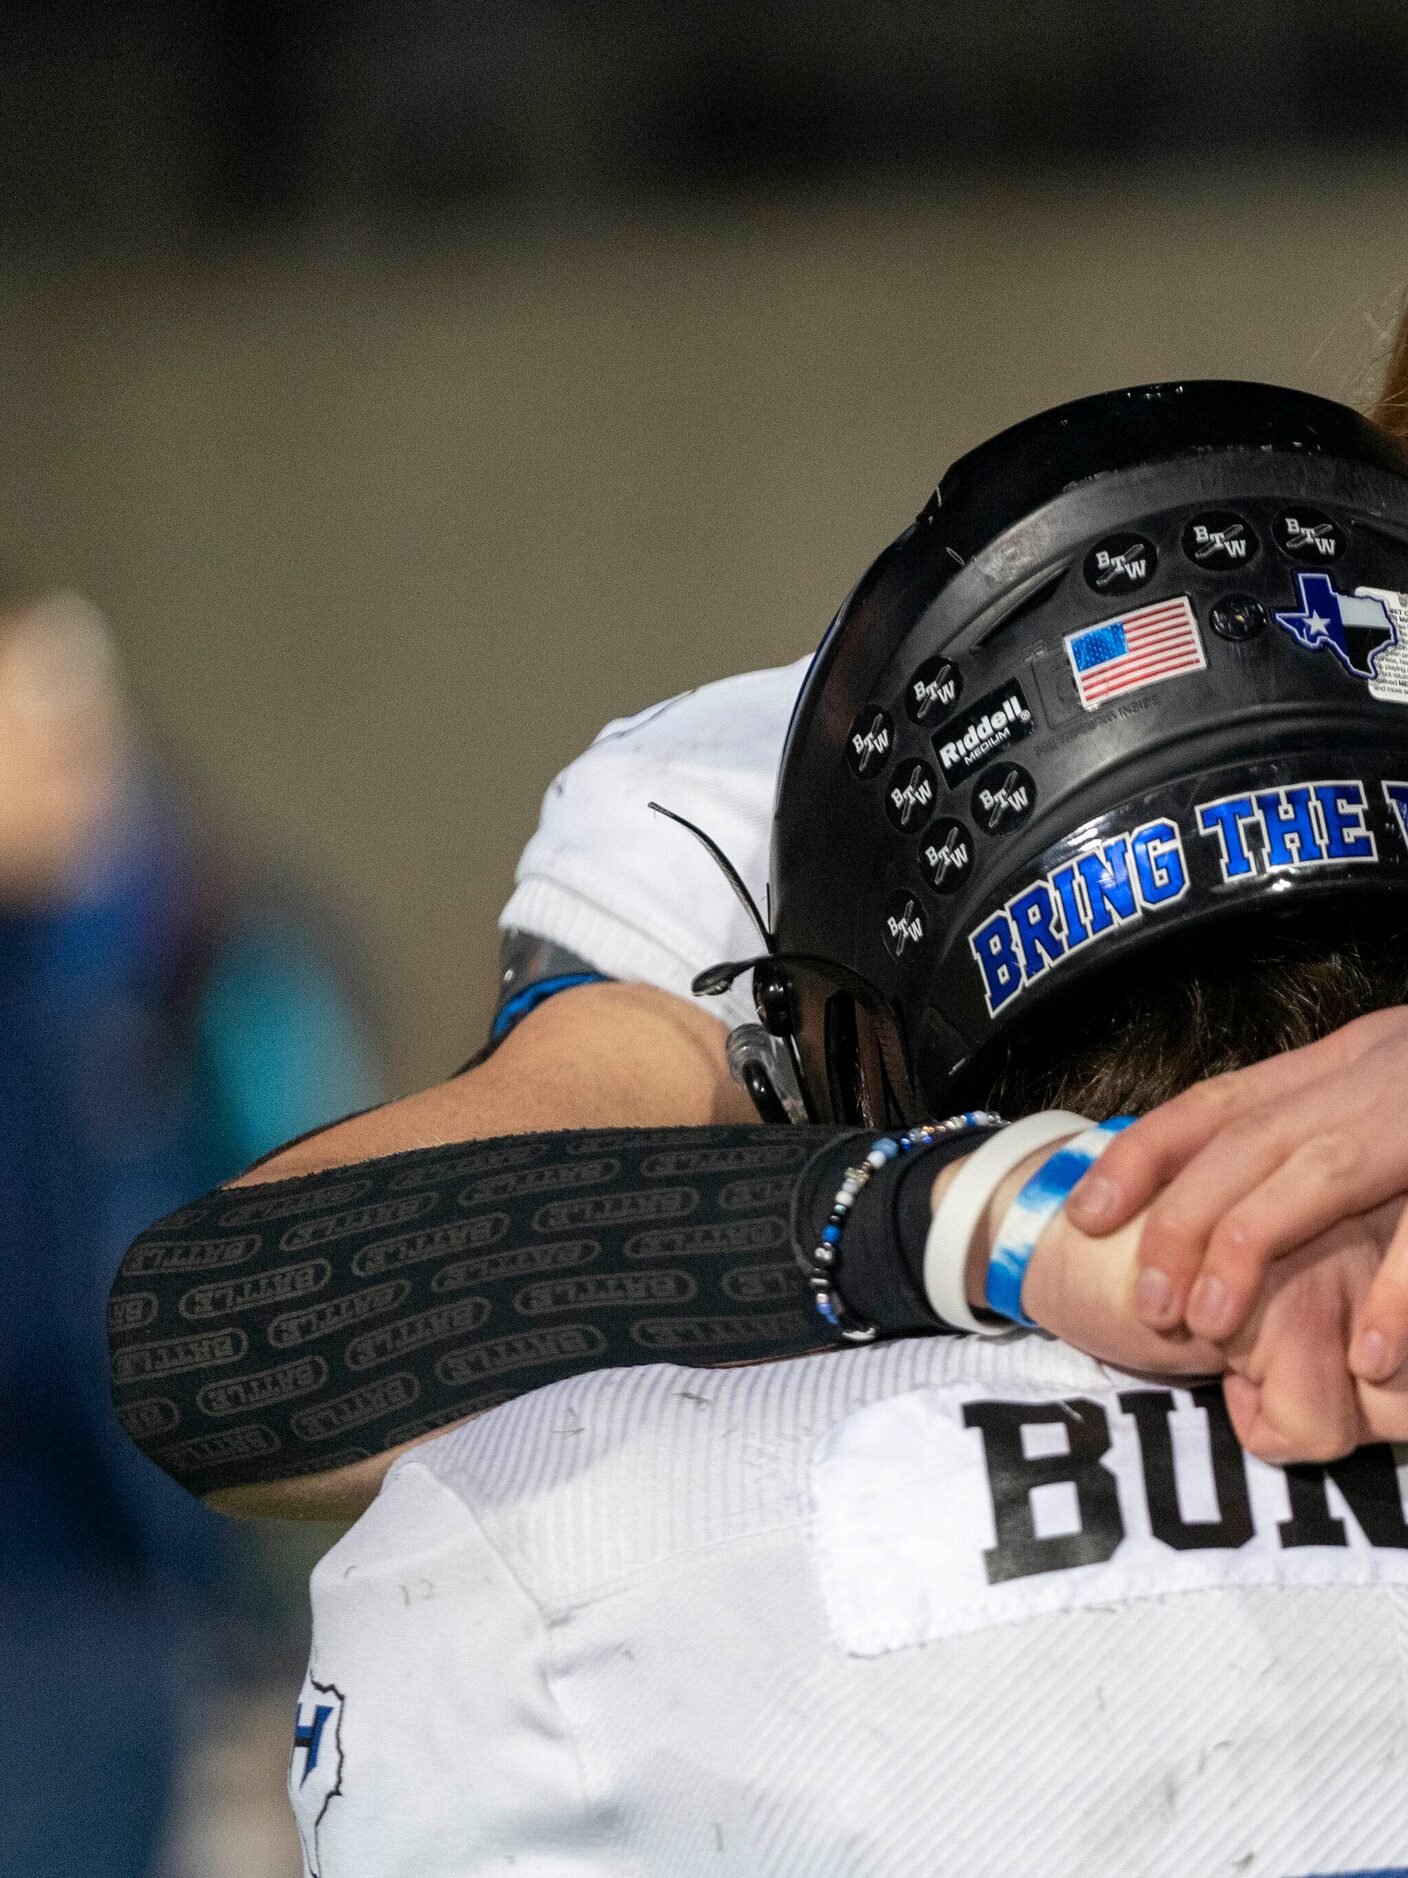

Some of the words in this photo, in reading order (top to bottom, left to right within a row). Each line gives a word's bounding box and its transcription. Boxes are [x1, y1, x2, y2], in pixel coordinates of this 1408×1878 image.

[1193, 525, 1246, 558] BTW
[1285, 517, 1336, 555] BTW
[1095, 550, 1147, 580] BTW
[914, 680, 956, 705] BTW
[852, 733, 889, 754] BTW
[964, 727, 1011, 766] MEDIUM
[891, 781, 932, 806] BTW
[981, 784, 1028, 812] BTW
[925, 844, 968, 869] BTW
[968, 817, 1190, 1019] BRING
[1196, 779, 1377, 883] THE
[887, 914, 923, 943] BTW
[545, 1193, 682, 1227] BATTLE
[362, 1221, 493, 1268] BATTLE
[191, 1271, 315, 1311] BATTLE
[527, 1276, 674, 1308] BATTLE
[350, 1306, 474, 1364] BATTLE
[201, 1365, 315, 1409] BATTLE
